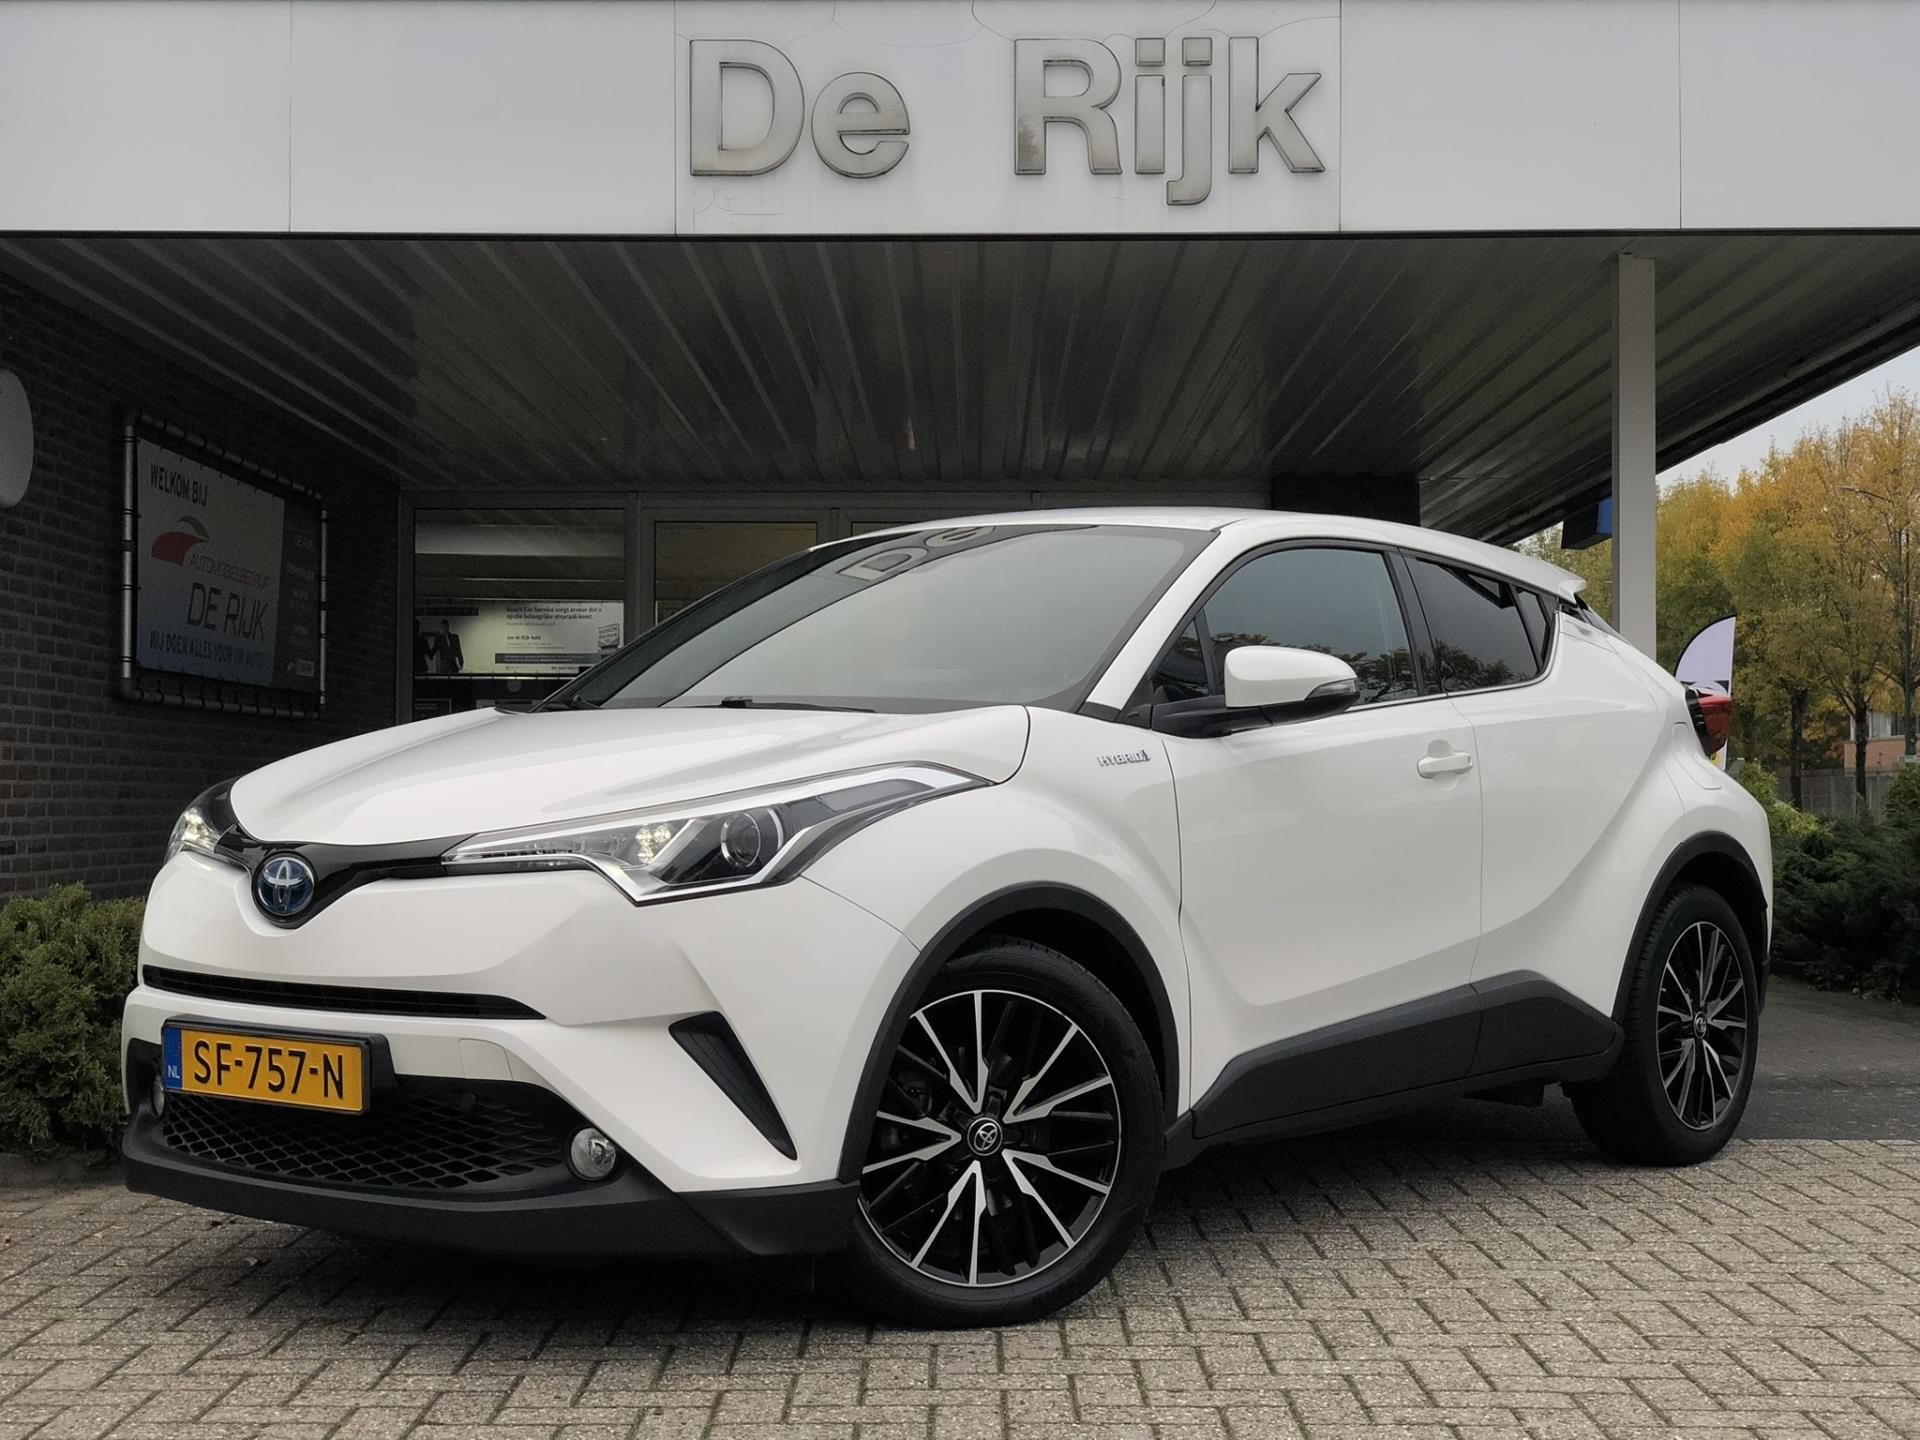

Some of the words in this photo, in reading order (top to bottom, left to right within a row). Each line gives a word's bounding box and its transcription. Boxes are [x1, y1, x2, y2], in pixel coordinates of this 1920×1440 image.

[689, 38, 911, 179] De
[1014, 36, 1326, 206] Rijk
[150, 462, 190, 501] WELKOM
[192, 480, 208, 507] BIJ
[187, 582, 221, 631] DE
[224, 592, 269, 642] RIJK
[167, 1065, 181, 1080] NL
[193, 1040, 344, 1100] SF-757-N
